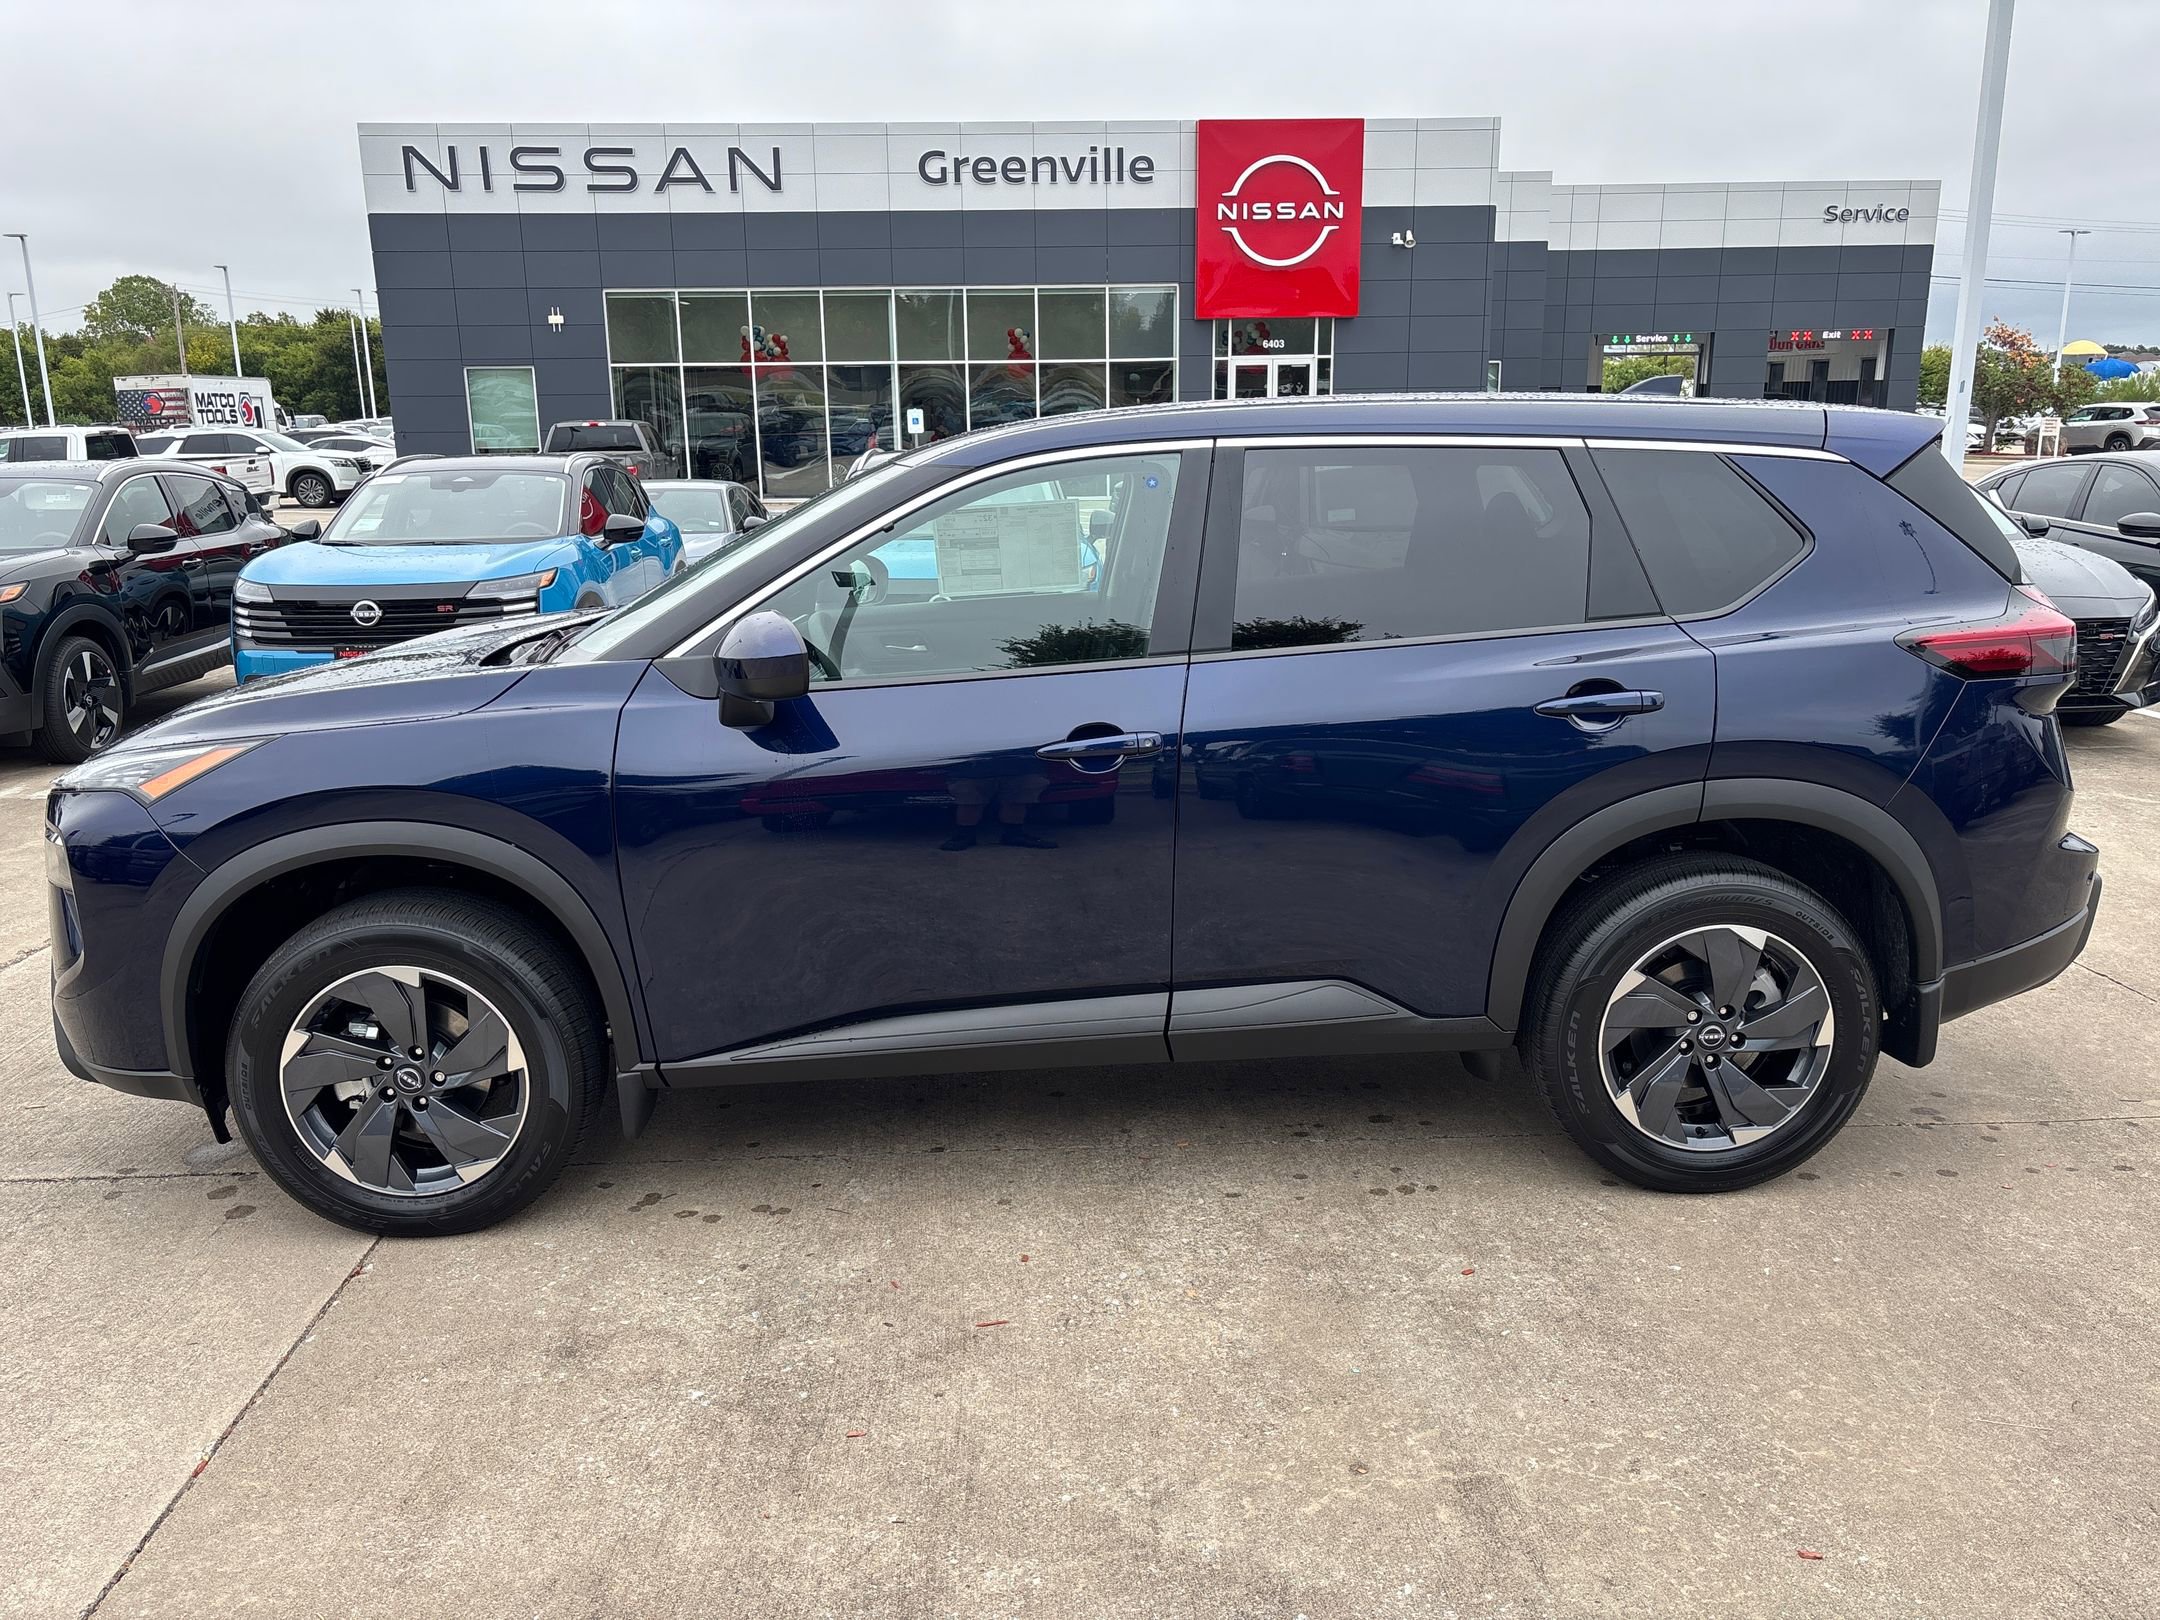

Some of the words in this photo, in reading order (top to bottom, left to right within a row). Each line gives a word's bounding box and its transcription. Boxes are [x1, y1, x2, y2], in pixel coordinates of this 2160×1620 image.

[401, 145, 784, 194] NISSAN
[917, 145, 1156, 186] Greenville
[1217, 201, 1345, 221] NISSAN
[1823, 202, 1910, 225] Service
[1635, 334, 1668, 343] Service
[1822, 330, 1842, 339] Exit
[1262, 339, 1285, 349] 6403
[194, 392, 236, 409] MATCO
[134, 416, 176, 427] MATCO
[197, 408, 239, 425] TOOLS
[246, 465, 260, 473] GMC
[436, 604, 455, 612] SR
[1794, 910, 1836, 941] OUTSIDE
[1849, 965, 1871, 1073] FALKEN
[1566, 1009, 1591, 1115] FALKEN
[240, 1062, 252, 1111] OUTSIDE
